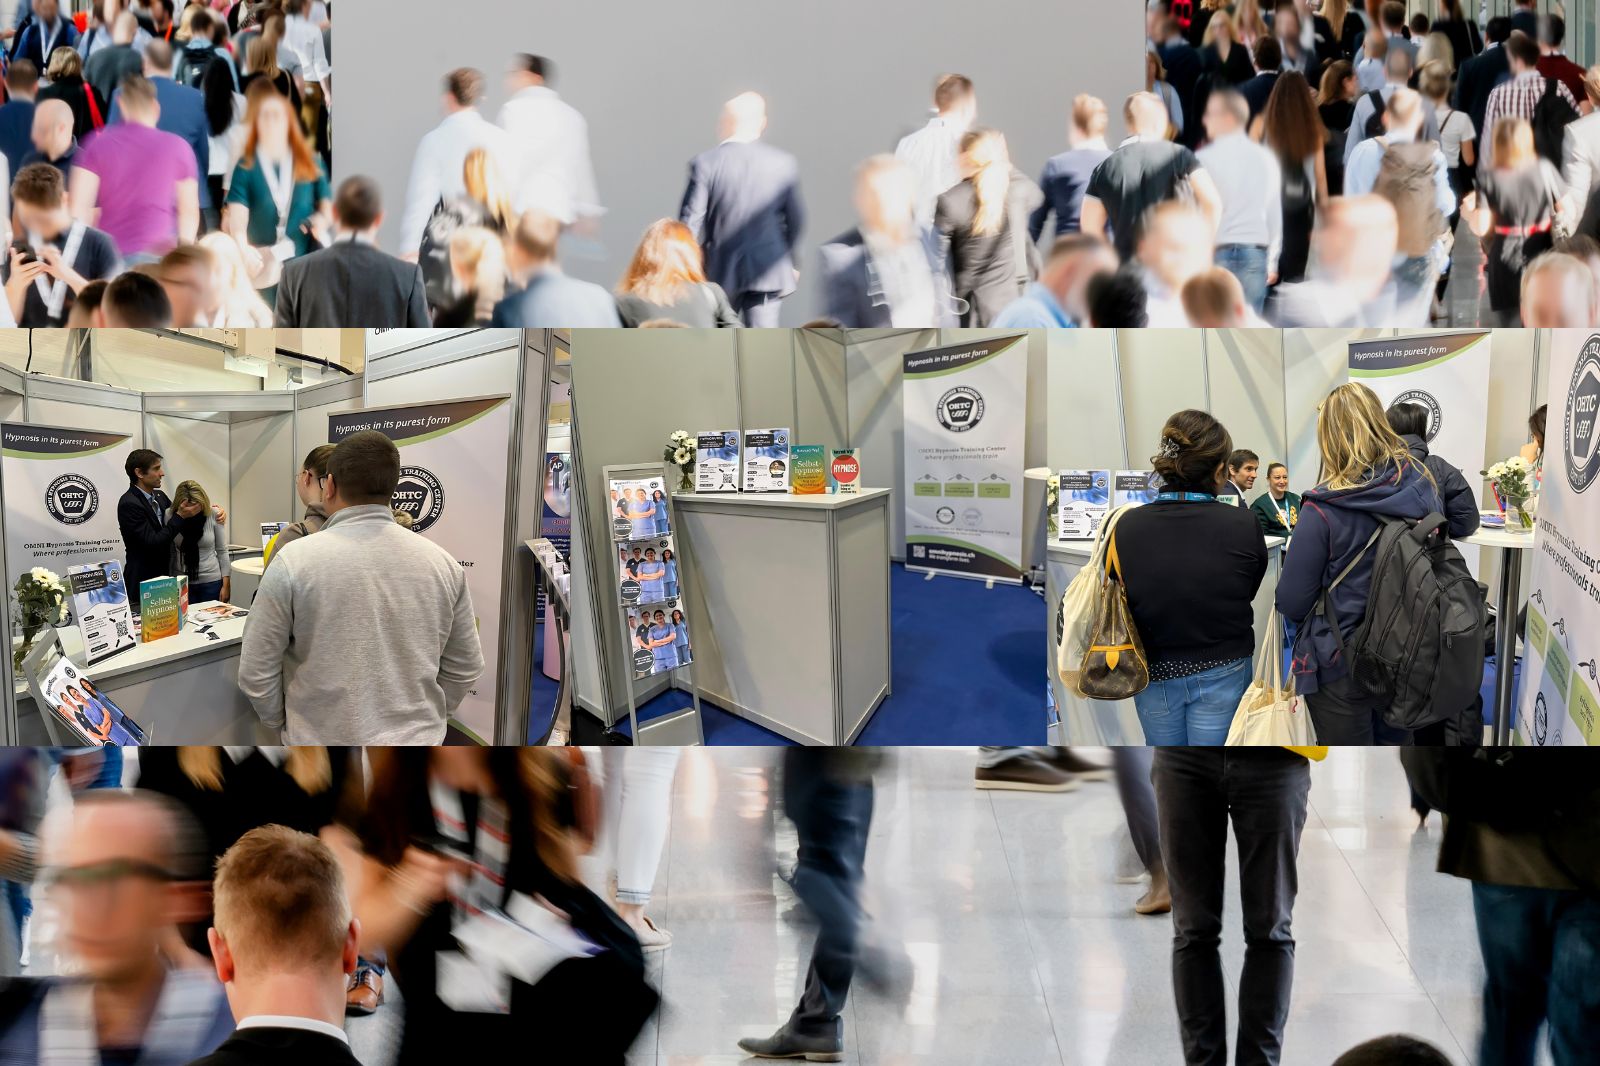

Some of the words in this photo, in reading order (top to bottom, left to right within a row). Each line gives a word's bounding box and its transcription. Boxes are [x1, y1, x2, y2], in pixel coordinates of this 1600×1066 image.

[908, 358, 933, 367] Hypnosis
[950, 352, 970, 361] purest
[971, 349, 988, 358] form
[1354, 350, 1384, 360] Hypnosis
[1404, 347, 1427, 357] purest
[1428, 346, 1447, 355] form
[1576, 394, 1597, 413] OHTC
[335, 422, 371, 434] Hypnosis
[373, 419, 381, 429] in
[383, 418, 394, 428] its
[396, 417, 425, 429] purest
[426, 415, 450, 428] form
[5, 432, 39, 442] Hypnosis
[82, 439, 99, 447] form
[834, 464, 857, 473] HYPNOSE
[404, 469, 437, 488] TRAINING
[430, 489, 441, 518] CENTER
[56, 547, 98, 556] professionals
[1571, 540, 1595, 572] Training
